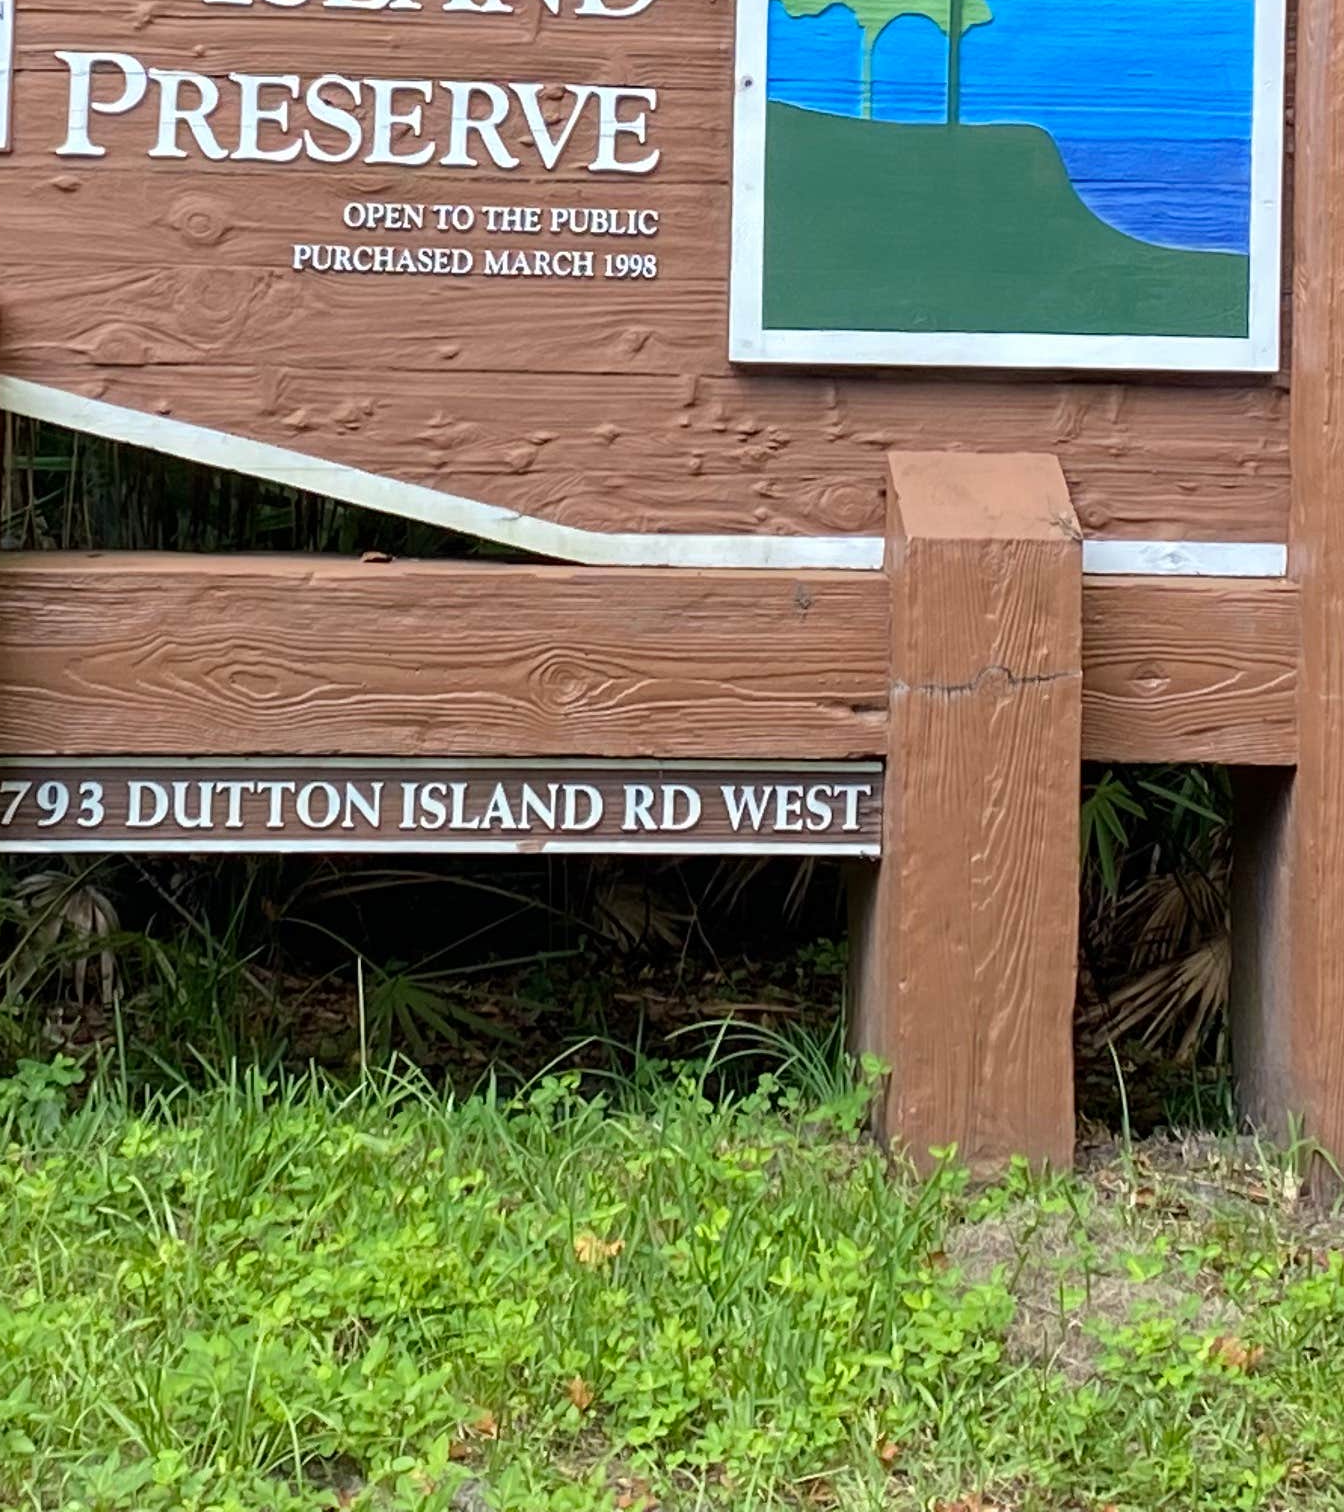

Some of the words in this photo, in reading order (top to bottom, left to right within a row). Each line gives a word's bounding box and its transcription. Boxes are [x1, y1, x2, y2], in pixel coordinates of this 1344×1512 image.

[54, 49, 661, 174] PRESERVE
[343, 202, 425, 229] OPEN
[432, 204, 475, 231] TO
[481, 206, 543, 233] THE
[549, 207, 659, 236] PUBLIC
[292, 244, 474, 275] PURCHASED
[483, 249, 595, 277] MARCH
[603, 253, 658, 279] 1998
[124, 780, 382, 830] DUTTON
[397, 781, 605, 832] ISLAND
[620, 783, 703, 833] RD
[723, 784, 874, 833] WEST
